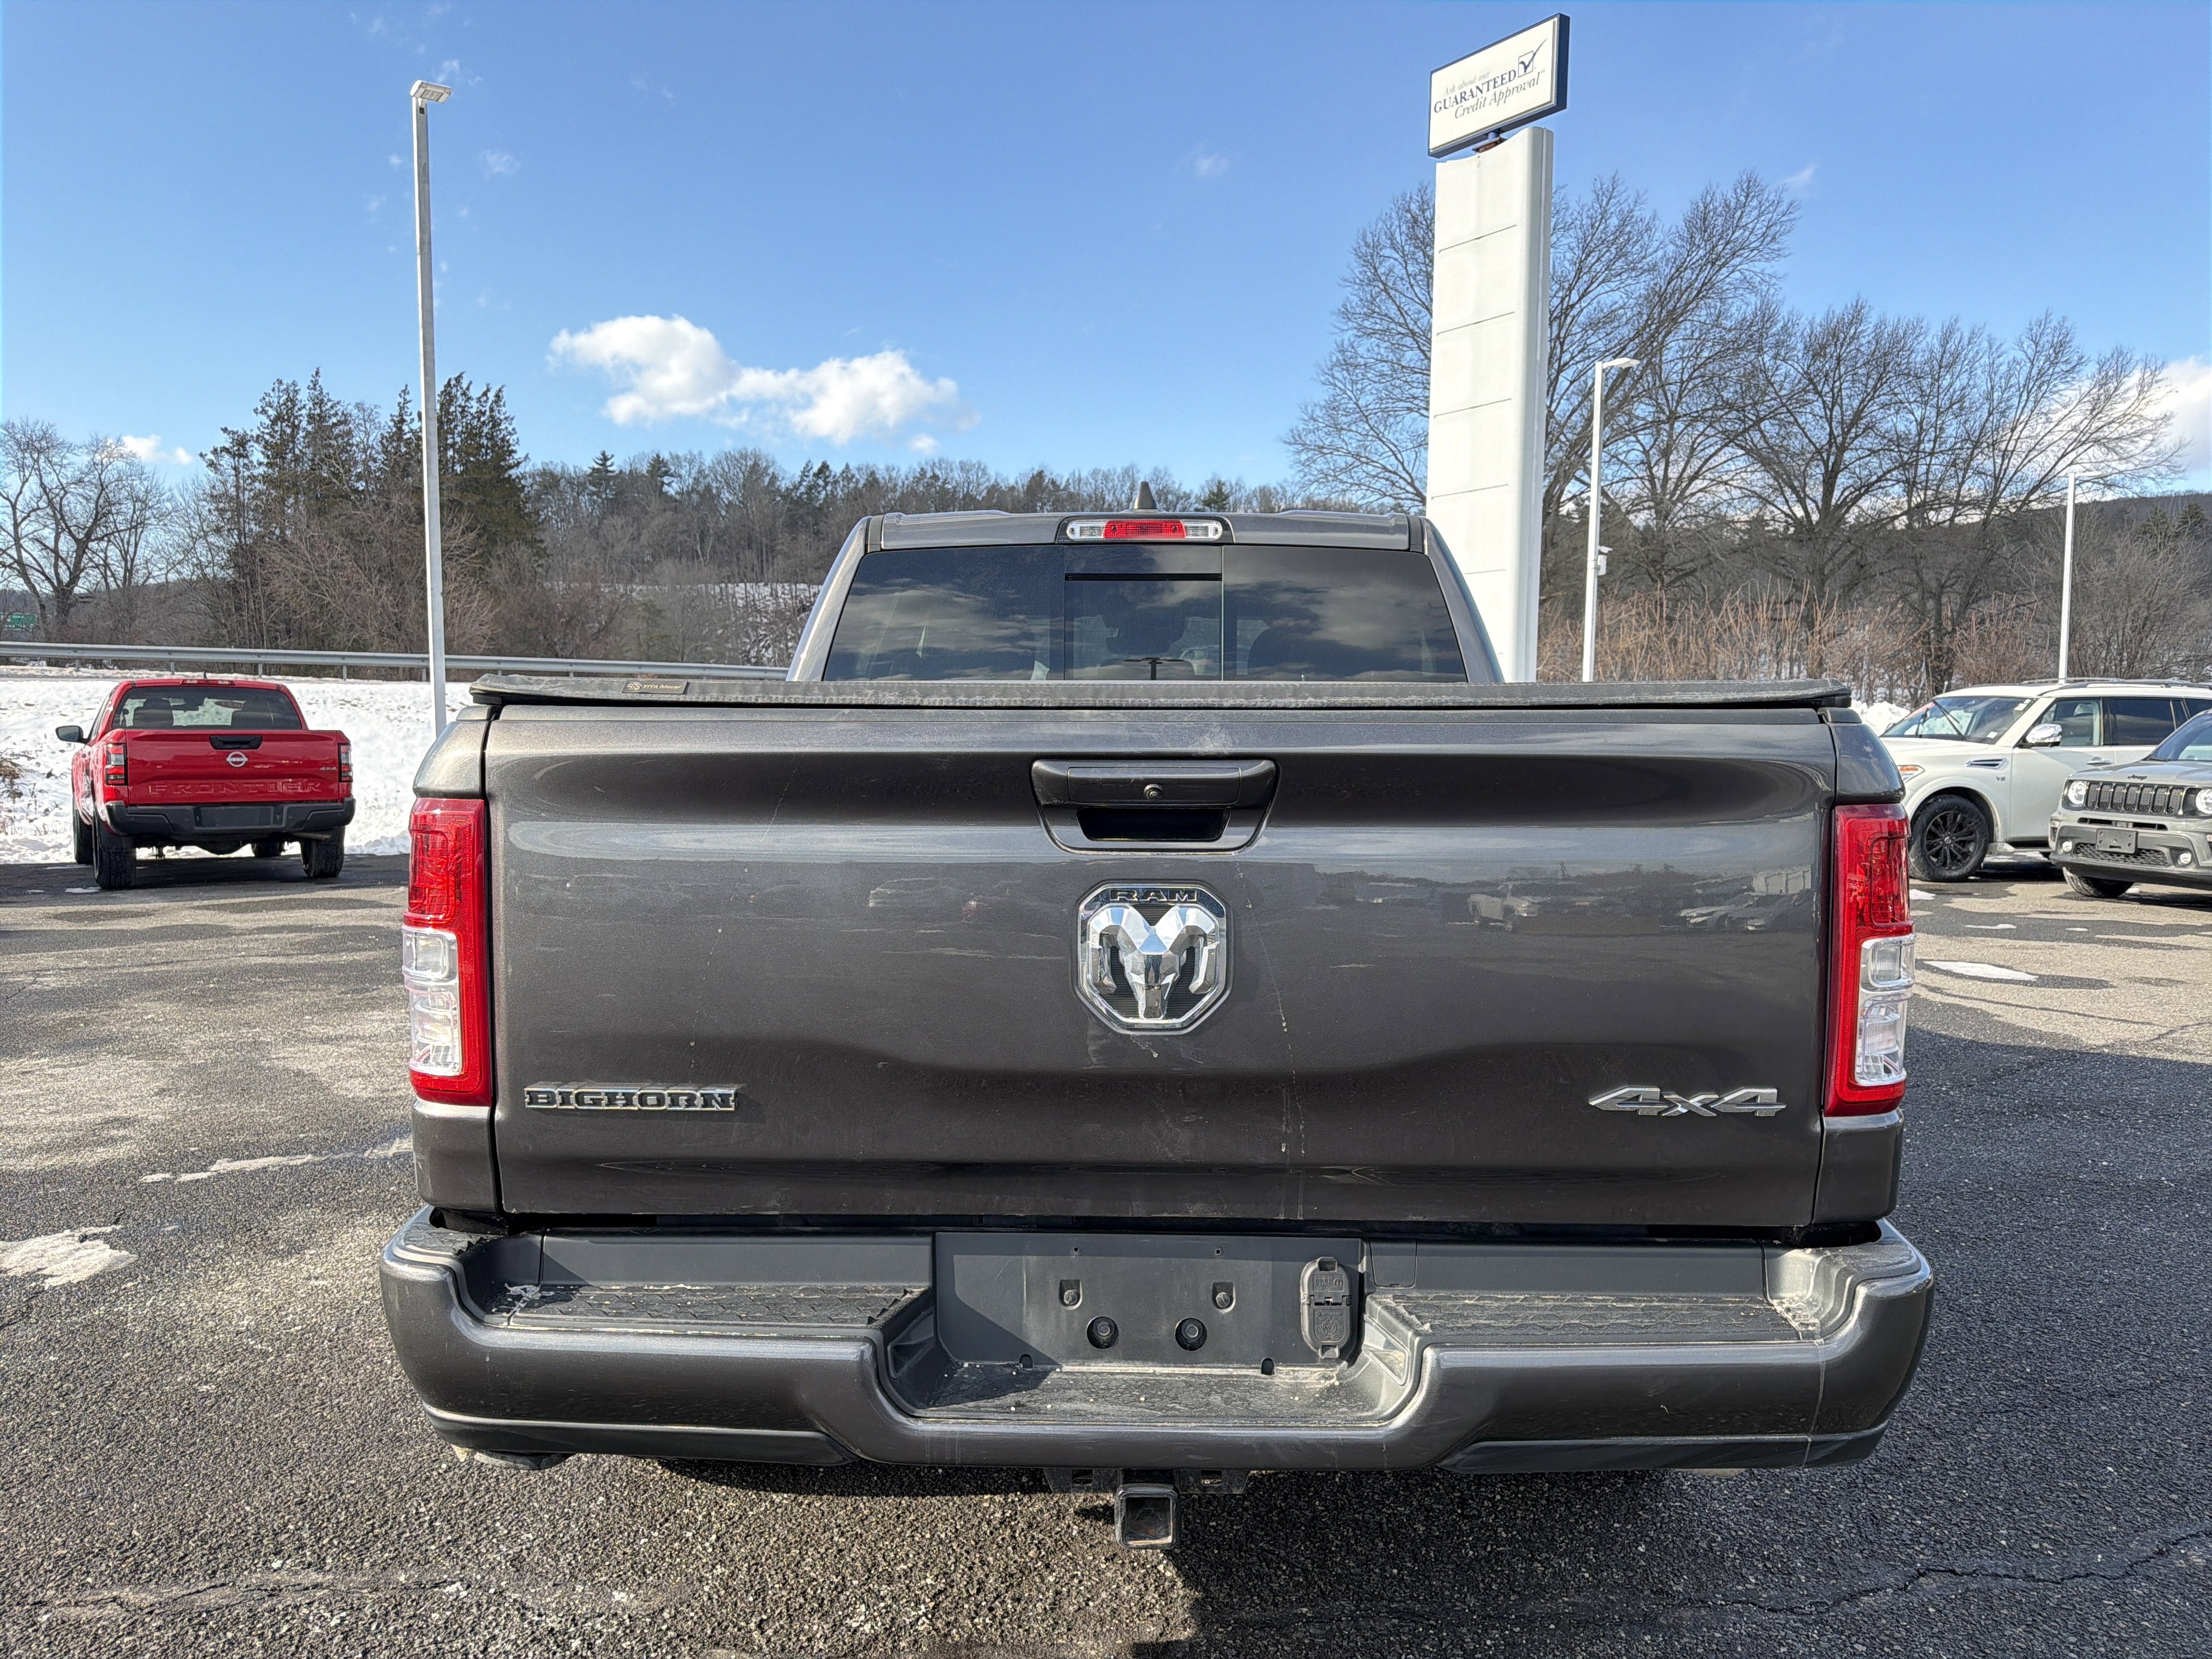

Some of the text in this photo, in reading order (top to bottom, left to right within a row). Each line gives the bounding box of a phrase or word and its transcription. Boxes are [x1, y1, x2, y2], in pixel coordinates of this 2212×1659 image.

[1434, 69, 1516, 114] GUARANTEED
[1454, 71, 1541, 119] Credit Approval
[149, 782, 322, 794] FRONTIER
[1109, 889, 1198, 902] RAM
[523, 1087, 738, 1112] BIGHORN
